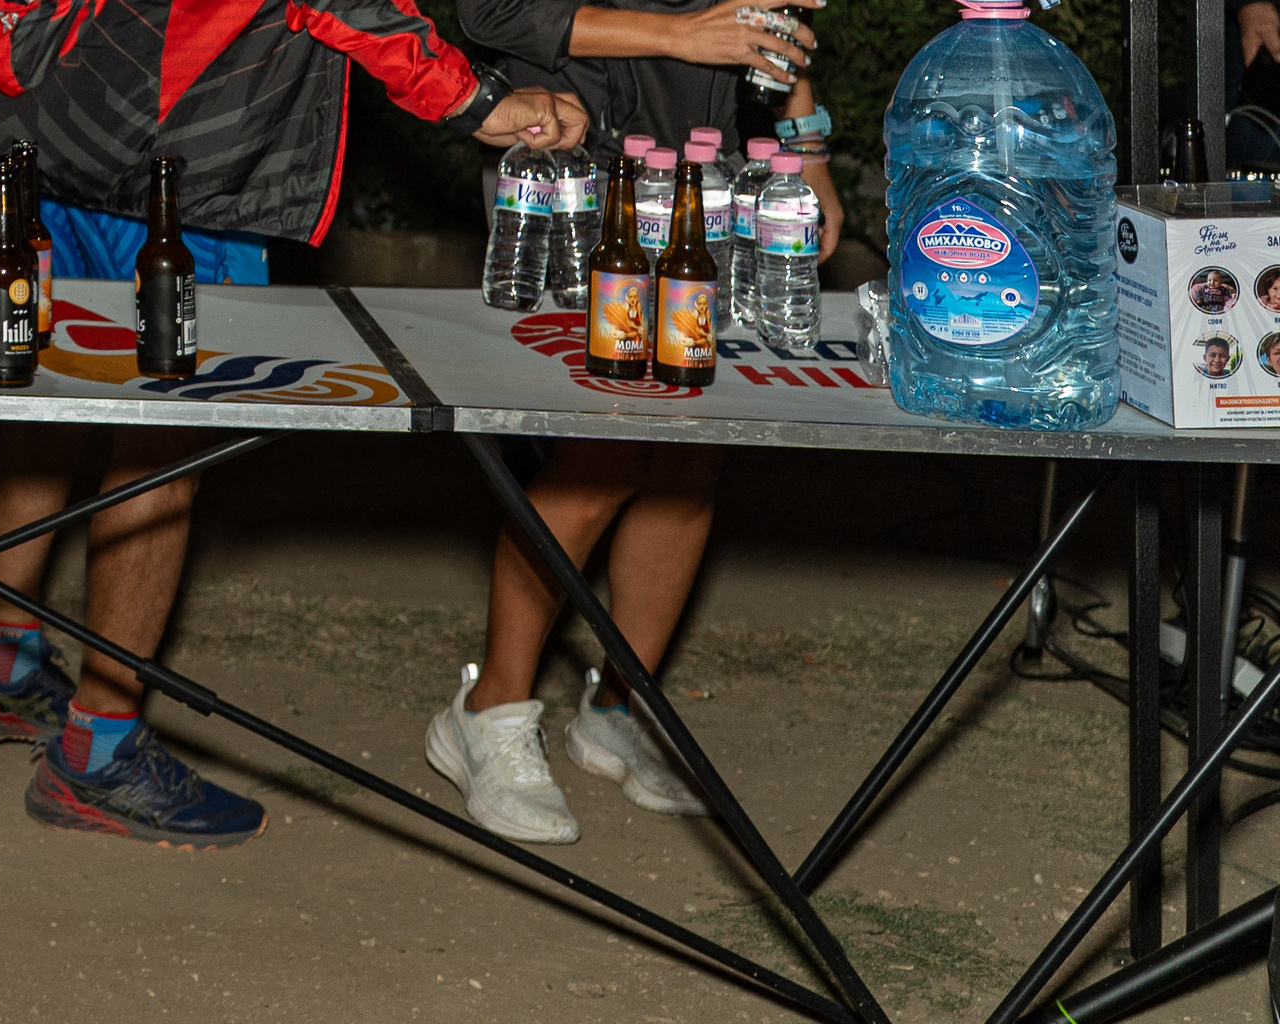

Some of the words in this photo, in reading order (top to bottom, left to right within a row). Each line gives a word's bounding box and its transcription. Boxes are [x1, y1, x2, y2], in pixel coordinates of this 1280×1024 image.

[517, 183, 553, 207] Vesa
[924, 236, 1002, 251] МИХАЛКОВО
[1267, 235, 1280, 247] ЗА
[2, 320, 33, 344] hills
[614, 339, 644, 351] MOMA
[683, 347, 713, 358] MOMA
[732, 365, 892, 389] HIL
